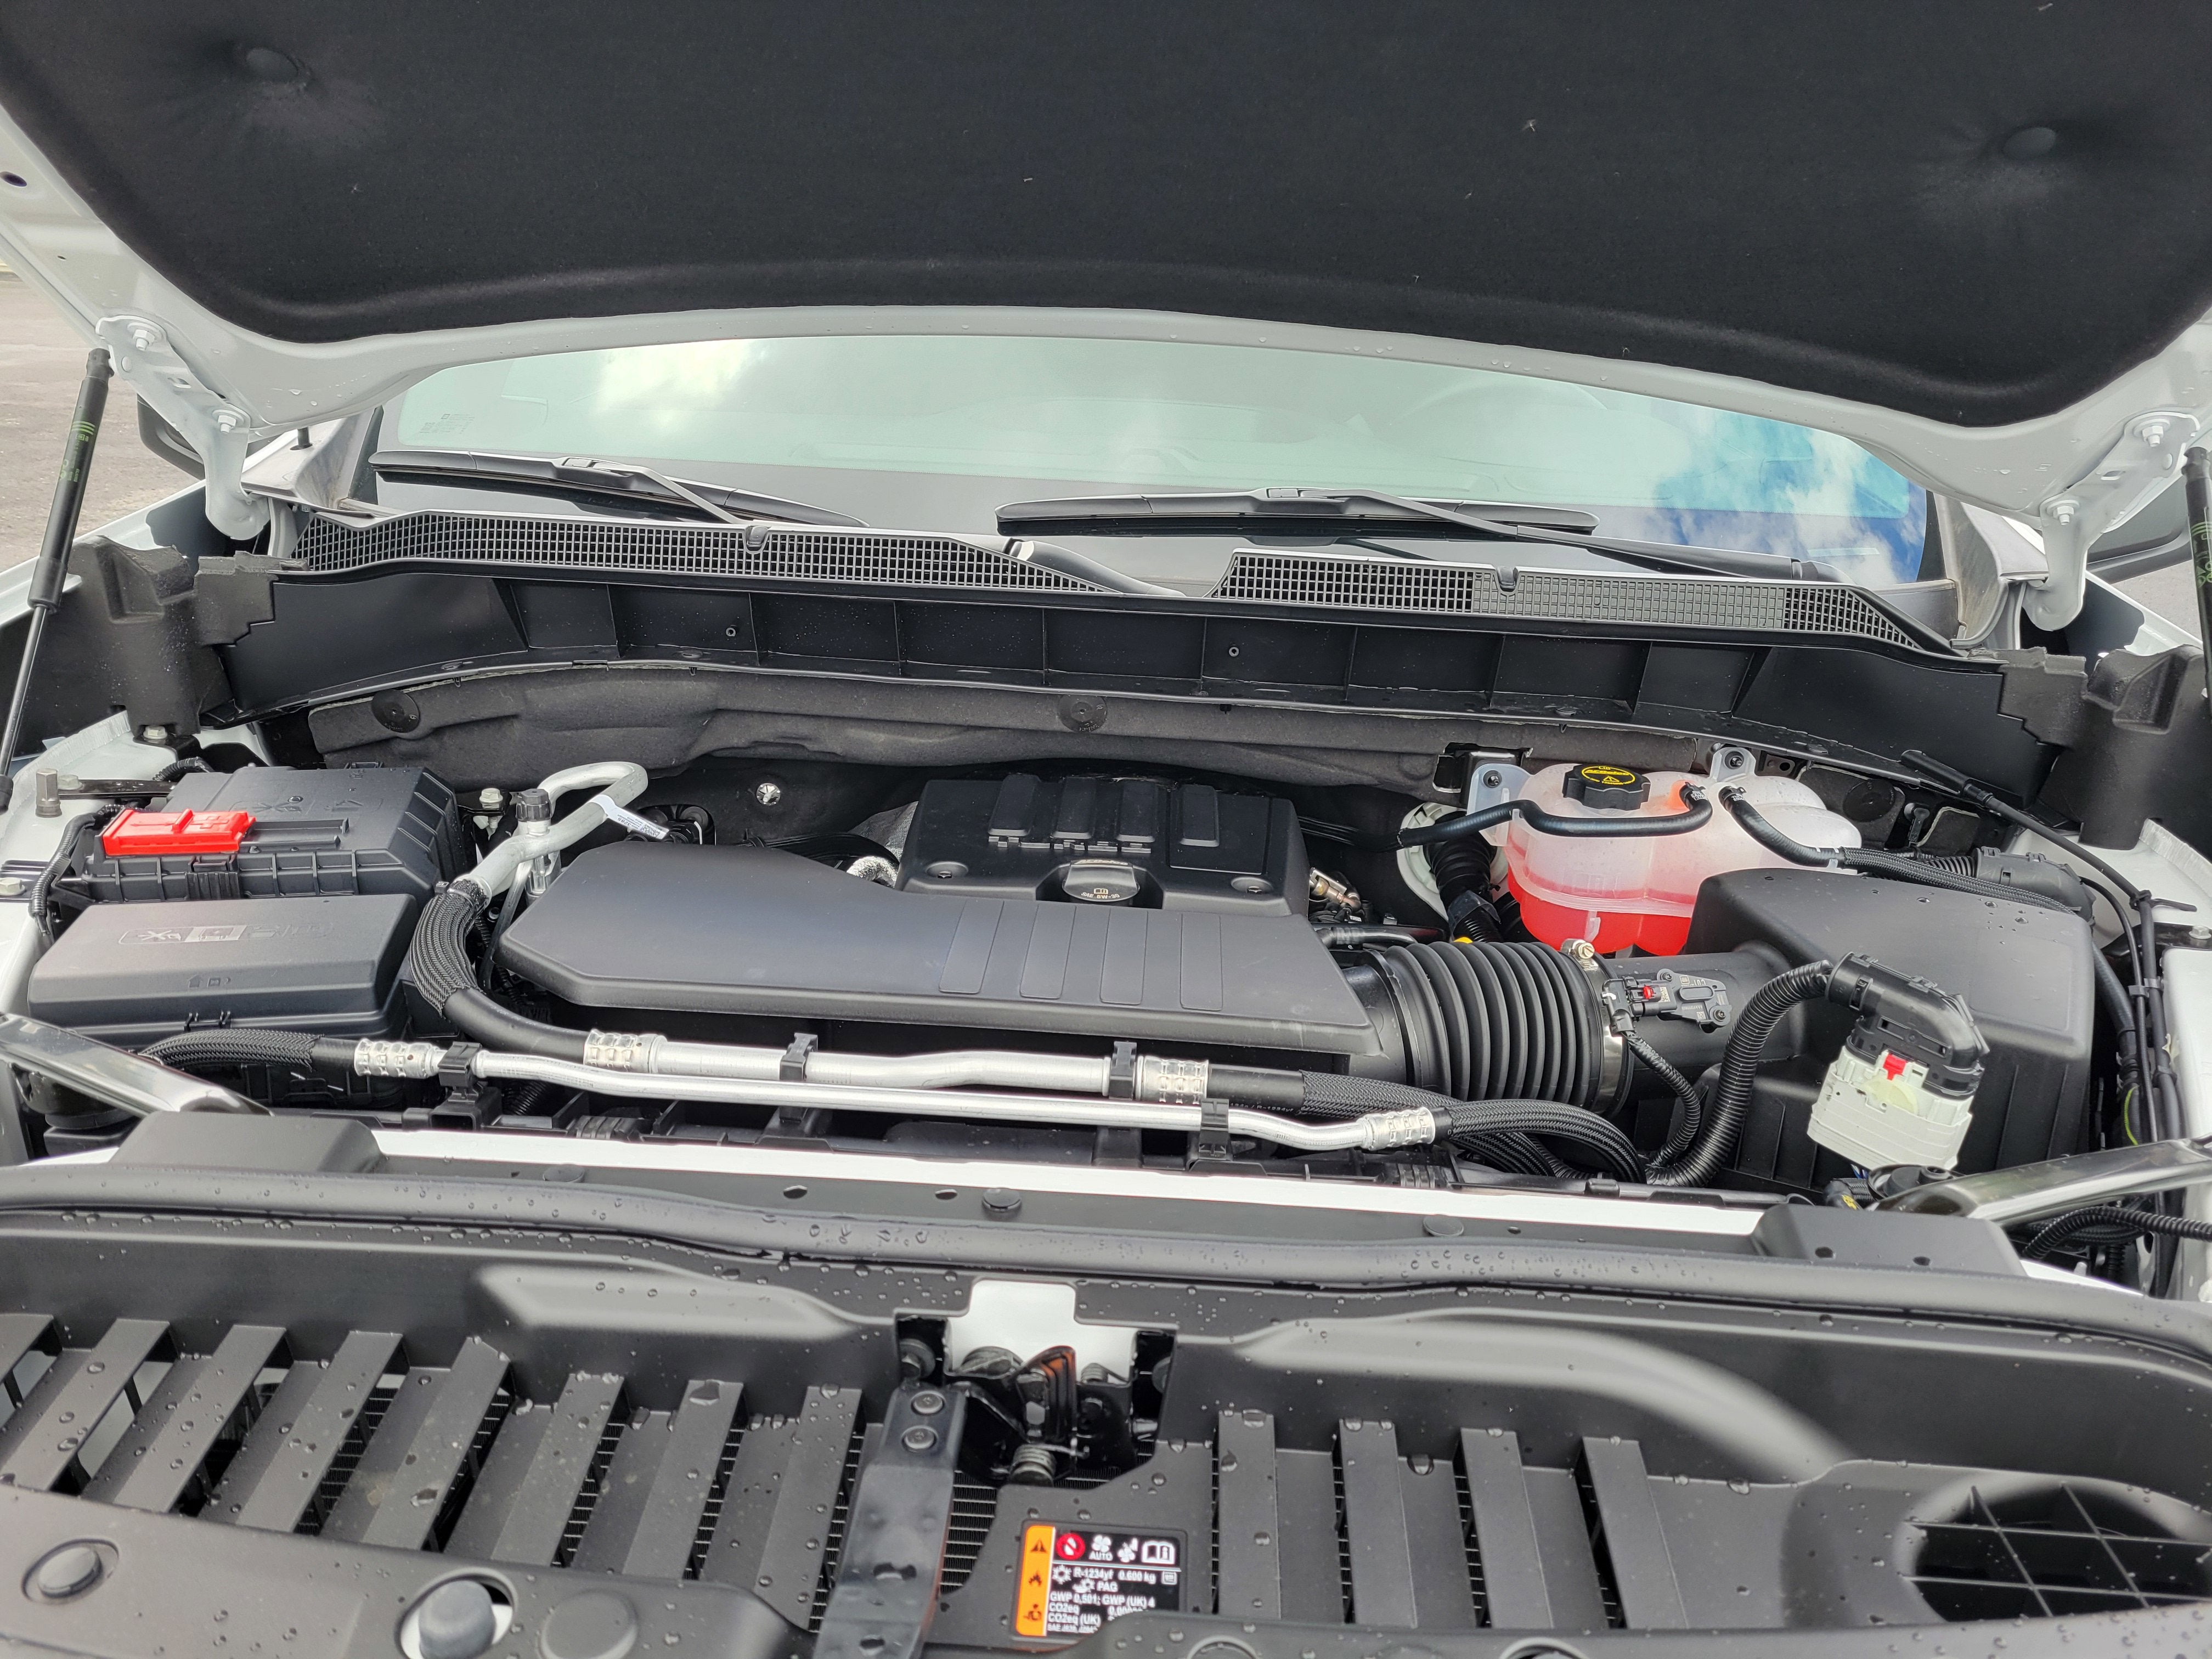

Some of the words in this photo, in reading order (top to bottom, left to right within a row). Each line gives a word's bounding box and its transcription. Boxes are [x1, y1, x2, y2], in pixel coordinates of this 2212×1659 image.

[1088, 1552, 1113, 1561] AUTO
[1073, 1567, 1114, 1580] R-1234yf
[1118, 1570, 1143, 1581] 0.600
[1143, 1571, 1156, 1584] kg
[1096, 1581, 1118, 1592] PAG
[1050, 1592, 1073, 1602] GWP
[1101, 1595, 1125, 1605] GWP
[1126, 1596, 1147, 1609] (UK)
[1148, 1597, 1155, 1607] 4
[1049, 1602, 1080, 1615] CO2eq
[1048, 1612, 1079, 1625] CO2eq
[1080, 1613, 1102, 1627] (UK)
[1047, 1623, 1062, 1632] SAE
